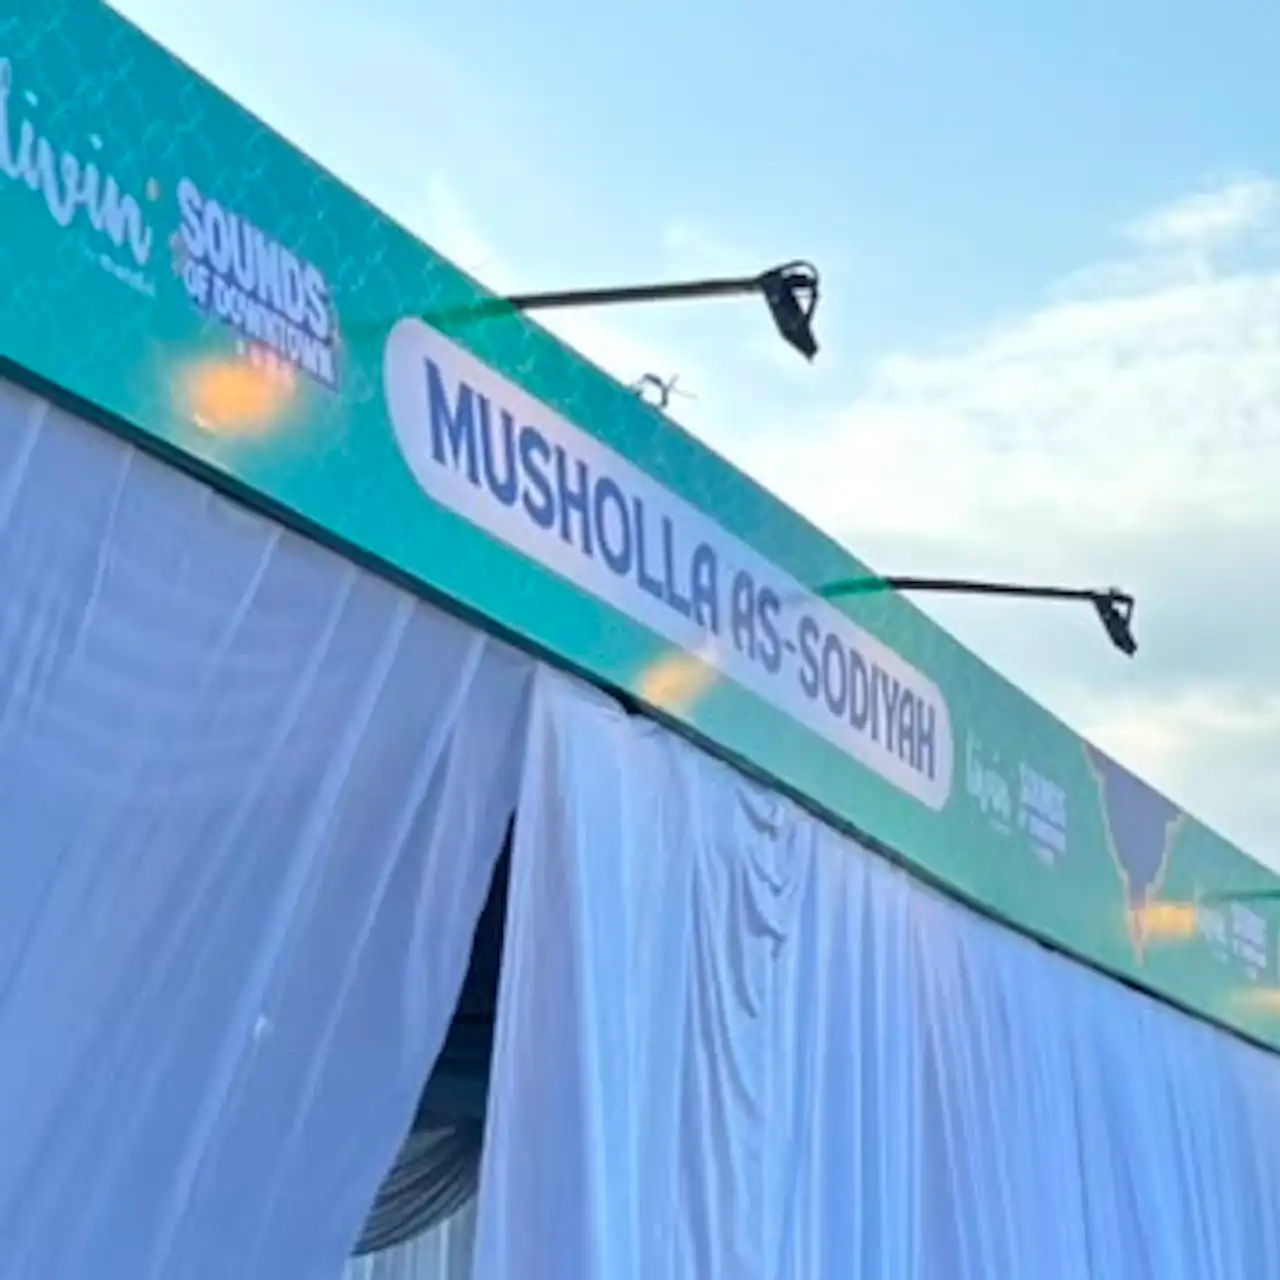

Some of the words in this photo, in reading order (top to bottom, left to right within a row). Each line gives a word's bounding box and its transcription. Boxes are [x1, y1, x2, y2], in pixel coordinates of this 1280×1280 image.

[177, 176, 333, 340] SOUNDS
[424, 355, 719, 635] MUSHOLLA
[731, 570, 937, 780] AS-SODIYAH
